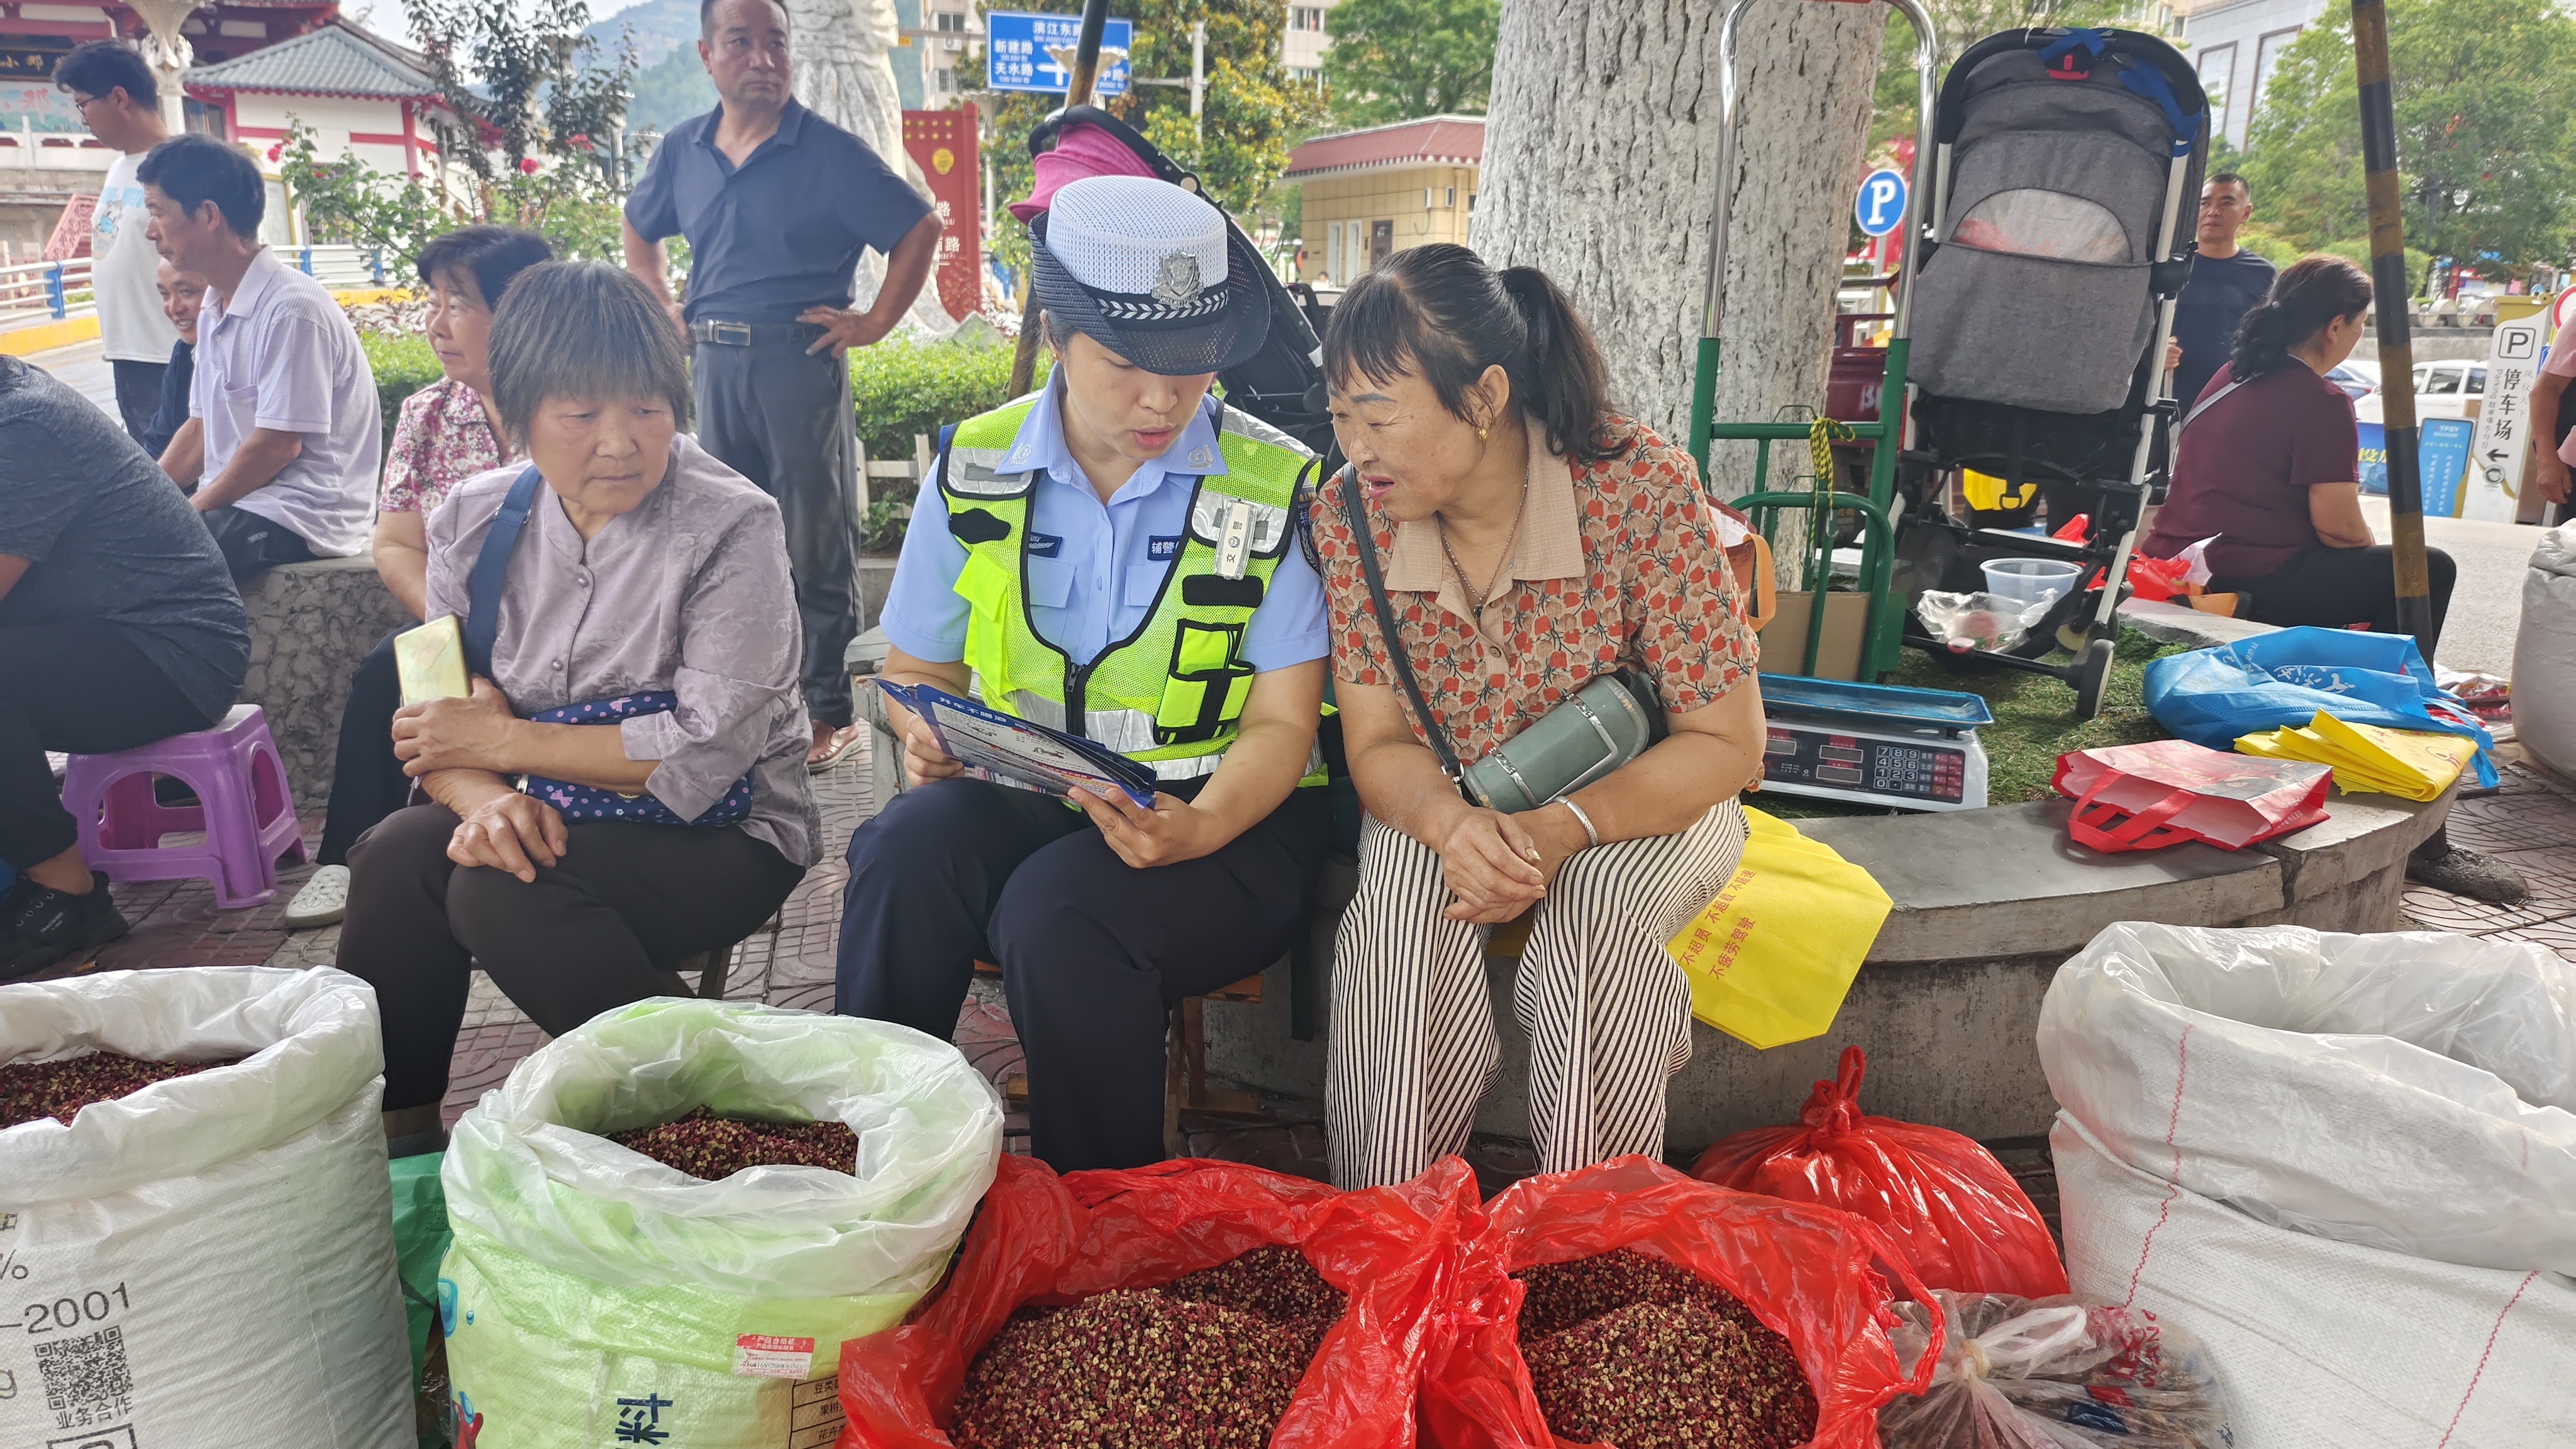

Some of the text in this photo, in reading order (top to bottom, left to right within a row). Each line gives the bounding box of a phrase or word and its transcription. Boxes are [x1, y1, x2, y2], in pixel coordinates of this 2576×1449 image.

[994, 40, 1033, 55] 新建路
[994, 62, 1033, 77] 天水路
[1867, 179, 1896, 225] P
[2507, 332, 2528, 354] P
[2489, 369, 2503, 399] Parking
[2494, 369, 2522, 441] 停车场
[1151, 541, 1175, 554] 辅警
[1909, 750, 1917, 758] 9
[1879, 758, 1916, 769] 4 5 6
[1892, 770, 1901, 778] 2
[1906, 772, 1915, 780] 3
[1877, 779, 1885, 787] 0
[1679, 869, 1757, 965] 不超员 不超载 不超速
[1708, 916, 1756, 980] 不疲劳驾驶
[757, 1335, 795, 1345] 产品合格证
[56, 1396, 133, 1430] 业务合作
